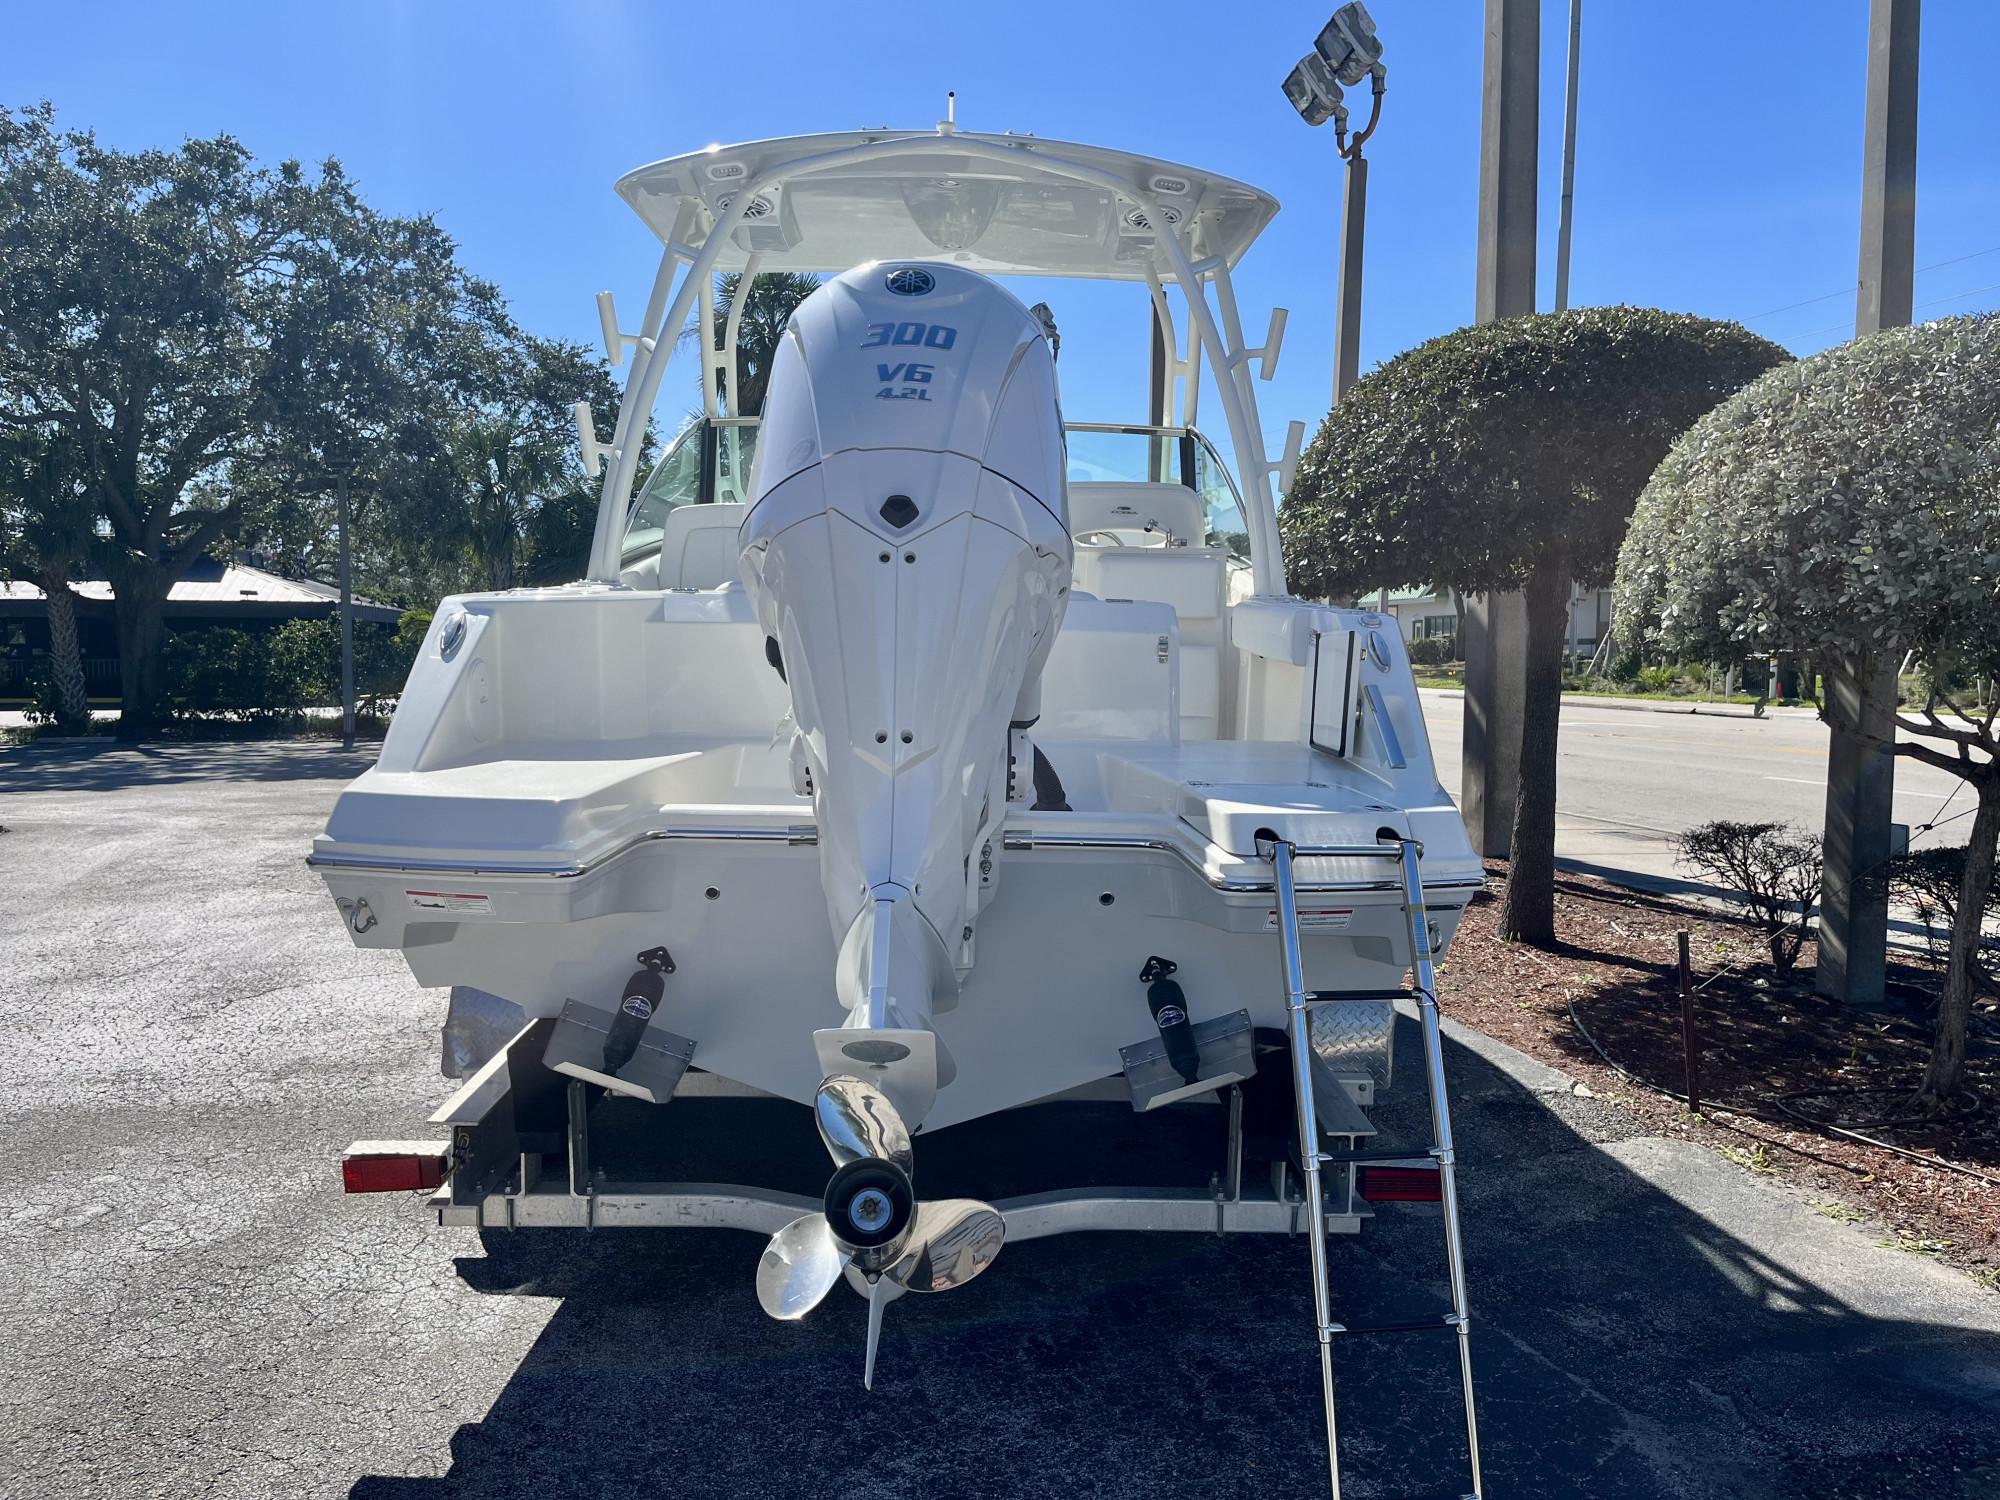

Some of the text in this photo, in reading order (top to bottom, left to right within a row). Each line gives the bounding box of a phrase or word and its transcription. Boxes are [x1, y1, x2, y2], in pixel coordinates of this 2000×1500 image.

[861, 322, 957, 350] 300
[877, 363, 934, 383] V6
[875, 387, 932, 402] 4.2L
